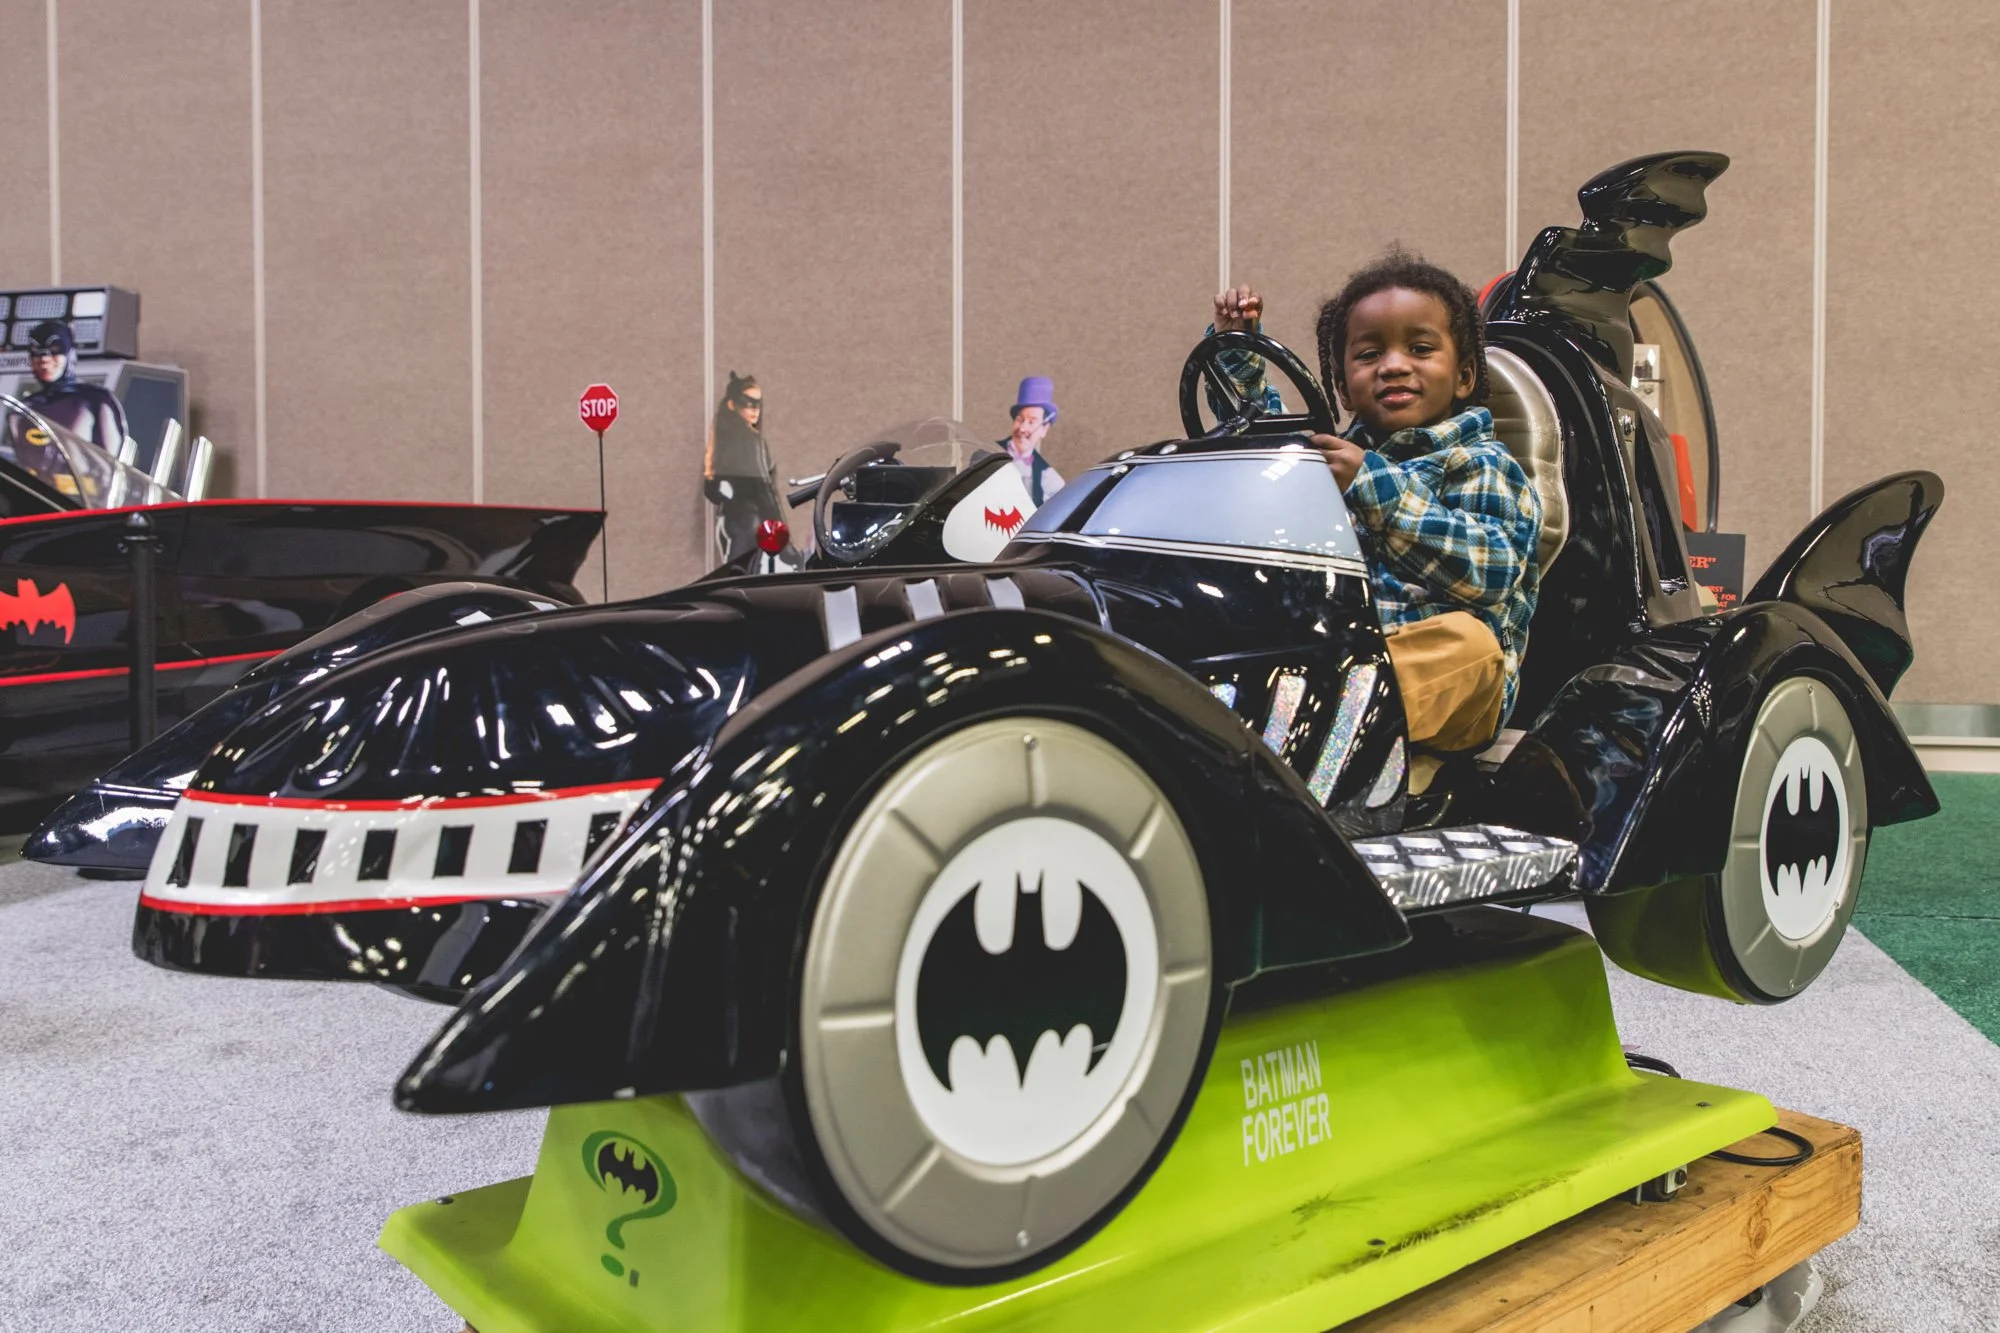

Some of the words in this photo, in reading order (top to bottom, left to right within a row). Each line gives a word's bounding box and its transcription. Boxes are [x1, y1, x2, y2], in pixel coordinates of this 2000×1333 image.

[582, 398, 616, 417] STOP
[1240, 1039, 1322, 1110] BATMAN
[1242, 1092, 1333, 1168] FOREVER
